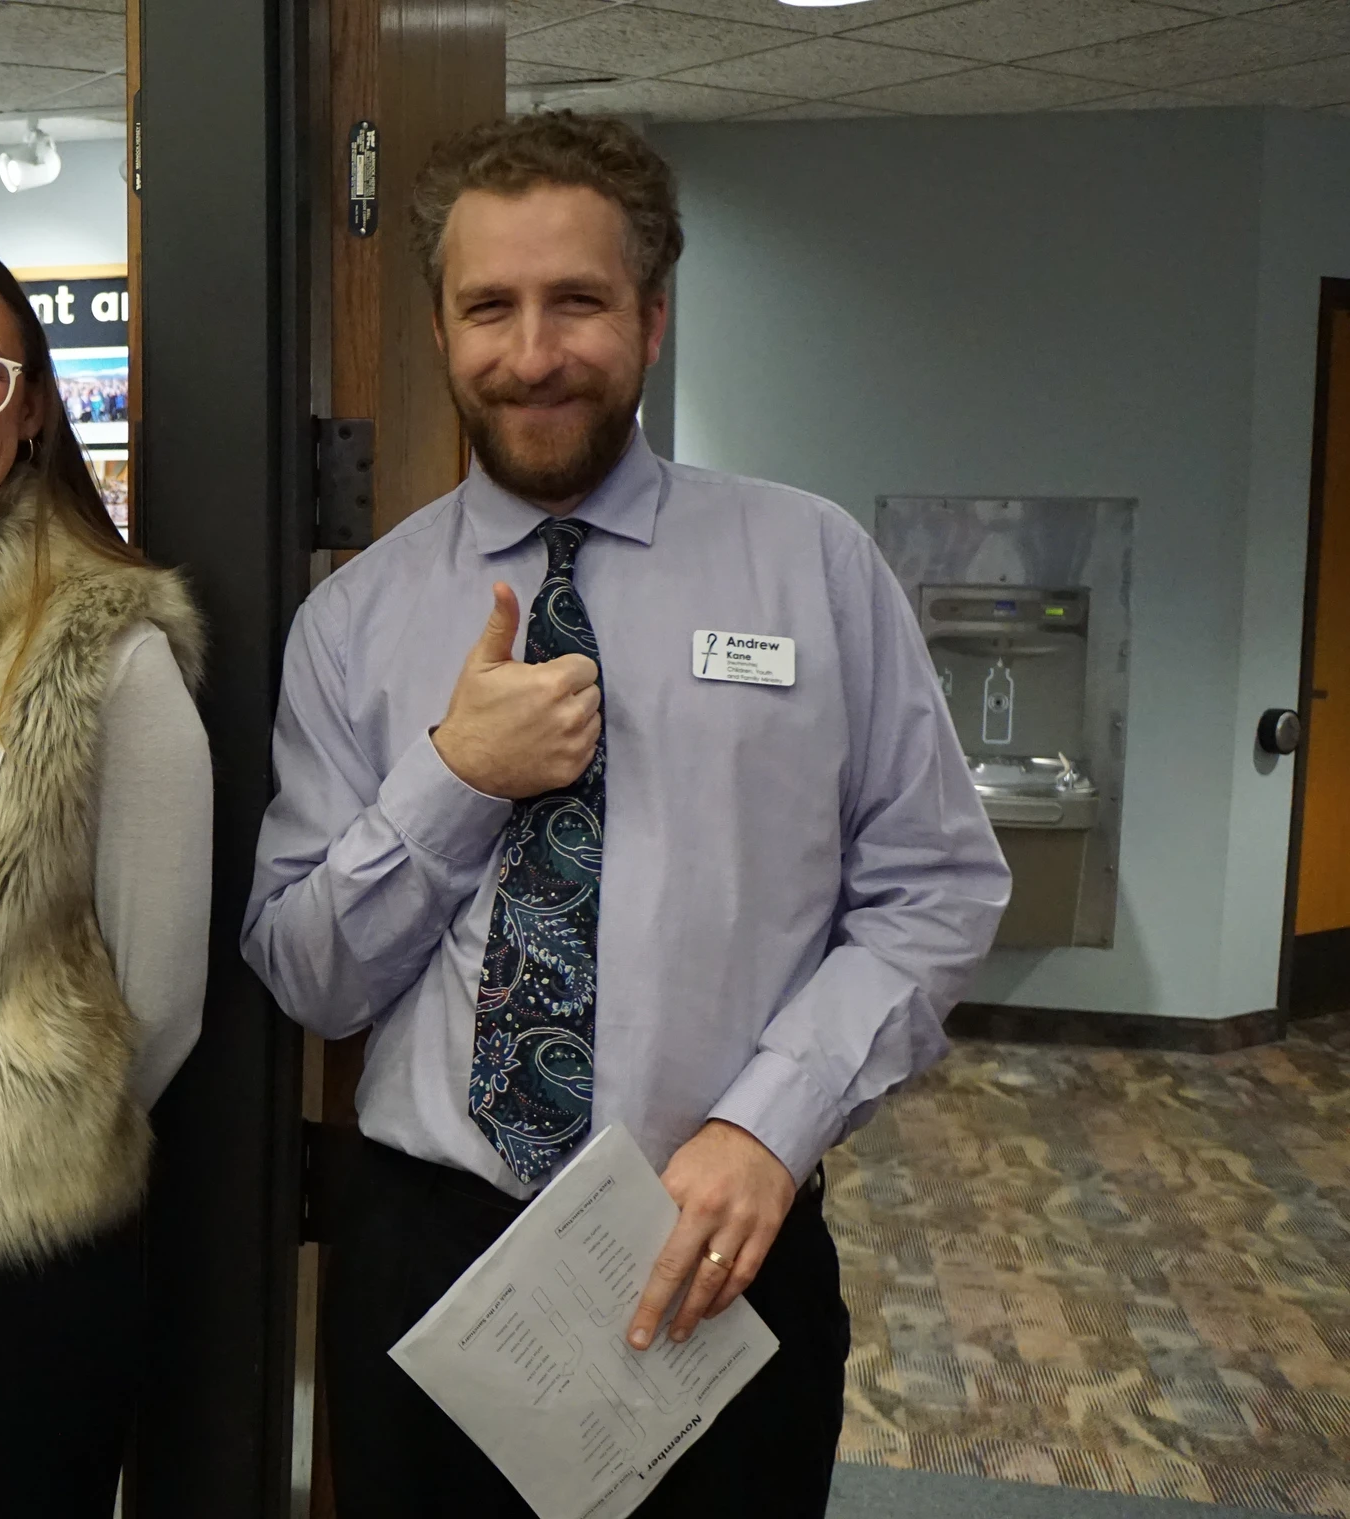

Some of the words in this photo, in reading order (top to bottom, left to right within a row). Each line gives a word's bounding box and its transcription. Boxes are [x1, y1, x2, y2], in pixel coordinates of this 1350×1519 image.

[726, 636, 780, 651] Andrew
[726, 651, 752, 661] Kane
[740, 674, 760, 683] Family
[598, 1179, 612, 1192] Back
[583, 1198, 593, 1209] the
[557, 1208, 584, 1234] Sanctuary
[499, 1287, 513, 1301] Back
[486, 1308, 496, 1319] the
[461, 1318, 487, 1346] Sanctuary
[648, 1414, 702, 1470] November
[637, 1472, 645, 1480] 1
